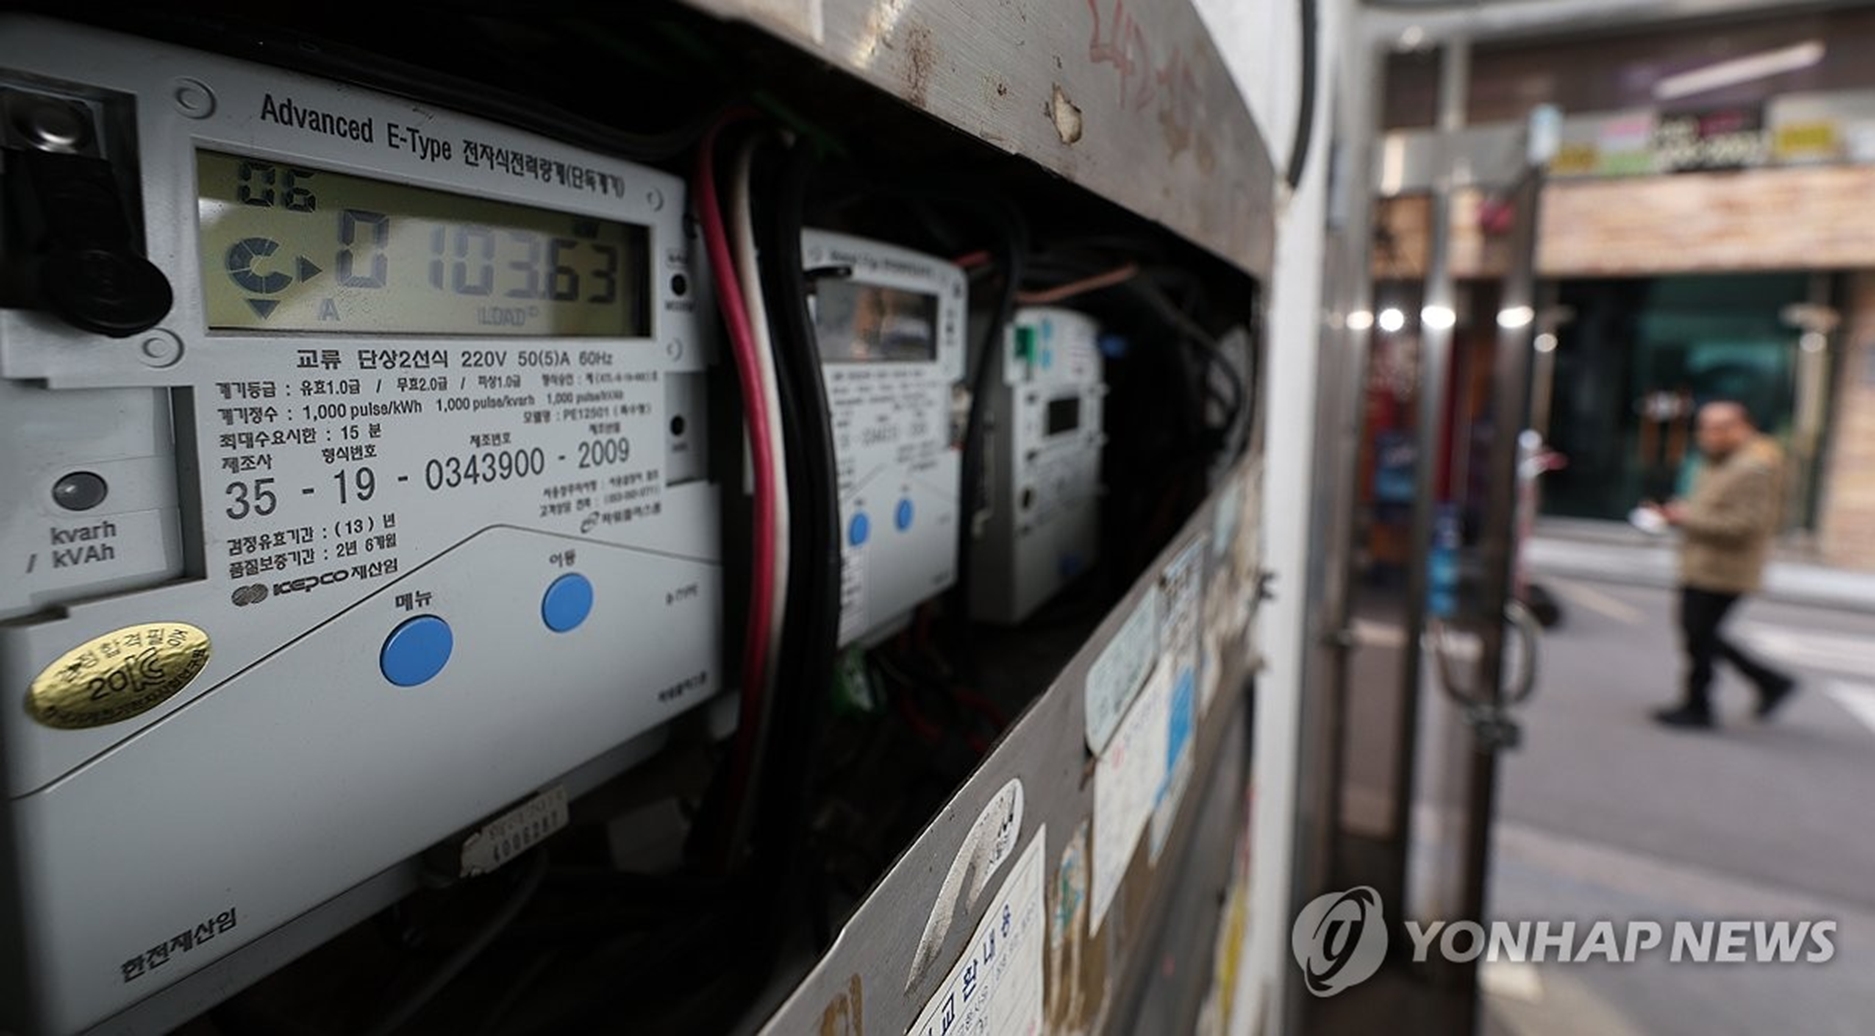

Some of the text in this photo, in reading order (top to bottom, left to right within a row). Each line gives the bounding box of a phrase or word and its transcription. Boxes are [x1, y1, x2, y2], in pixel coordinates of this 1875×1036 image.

[260, 93, 374, 144] Advanced
[386, 122, 452, 163] E-Type
[237, 161, 316, 213] 06
[317, 298, 341, 322] A
[296, 349, 613, 370] 교류 단상2선식 220V 50(5)A 60Hz
[300, 379, 360, 396] 유효1.0급
[397, 377, 448, 392] 무효2.0급
[303, 403, 347, 422] 1,000
[350, 399, 423, 420] pulse/kWh
[436, 397, 470, 413] 1,000
[219, 427, 316, 450] 최대수요시한
[341, 425, 359, 440] 15
[367, 423, 382, 439] 분
[221, 454, 272, 474] 제조사
[321, 443, 378, 464] 형식번호
[225, 477, 277, 520] 35
[333, 466, 376, 504] 19
[425, 446, 545, 491] 0343900
[578, 437, 630, 469] 2009
[50, 519, 117, 546] kvarh
[226, 526, 314, 556] 검정유효기간
[382, 513, 396, 529] 년
[52, 543, 116, 569] kVAh
[228, 548, 315, 580] 품질보증기간
[336, 540, 358, 558] 2년
[365, 532, 397, 553] 6개월
[394, 588, 433, 612] 메뉴
[121, 906, 237, 984] 한전재산임
